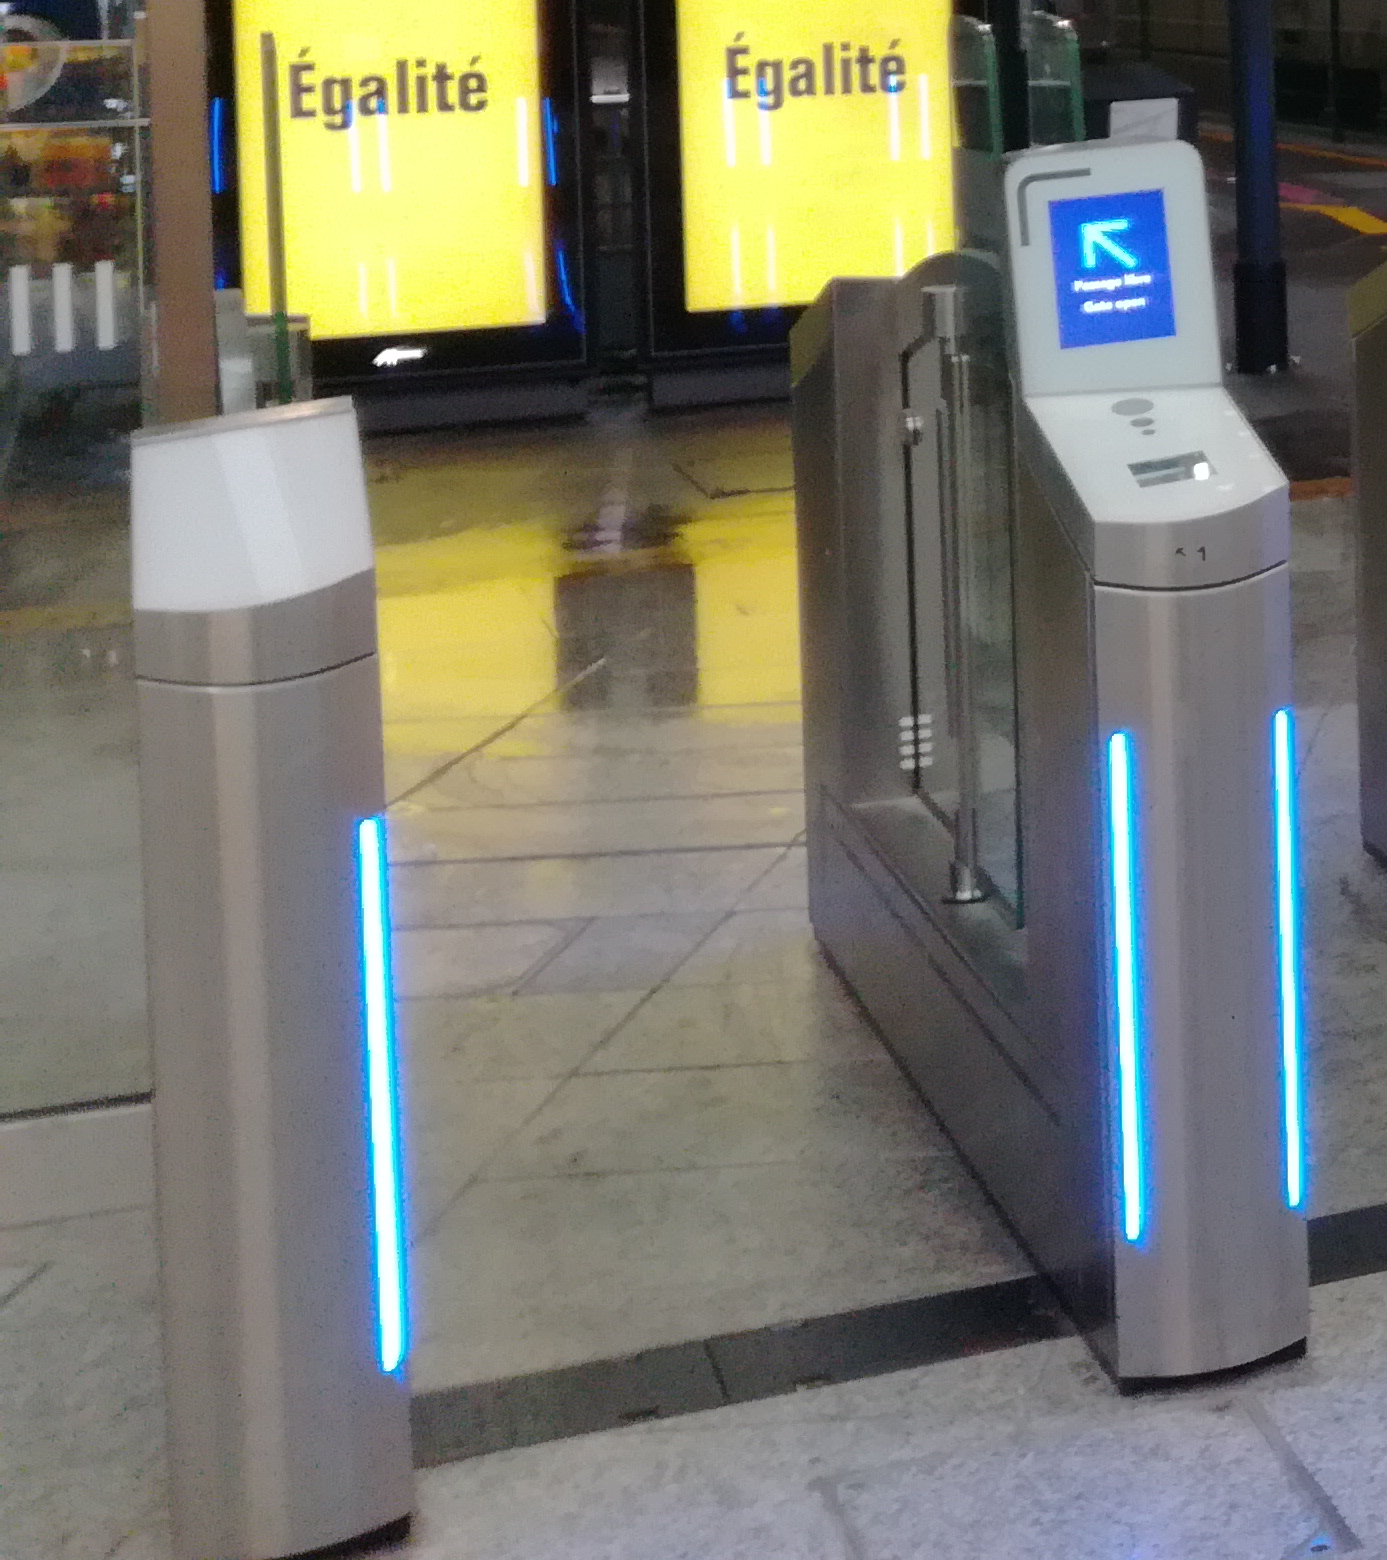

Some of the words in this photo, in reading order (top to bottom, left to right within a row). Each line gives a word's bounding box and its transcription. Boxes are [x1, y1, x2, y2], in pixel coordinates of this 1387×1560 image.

[289, 46, 489, 131] Égalité
[726, 31, 907, 111] Égalité
[1197, 546, 1206, 561] 1
